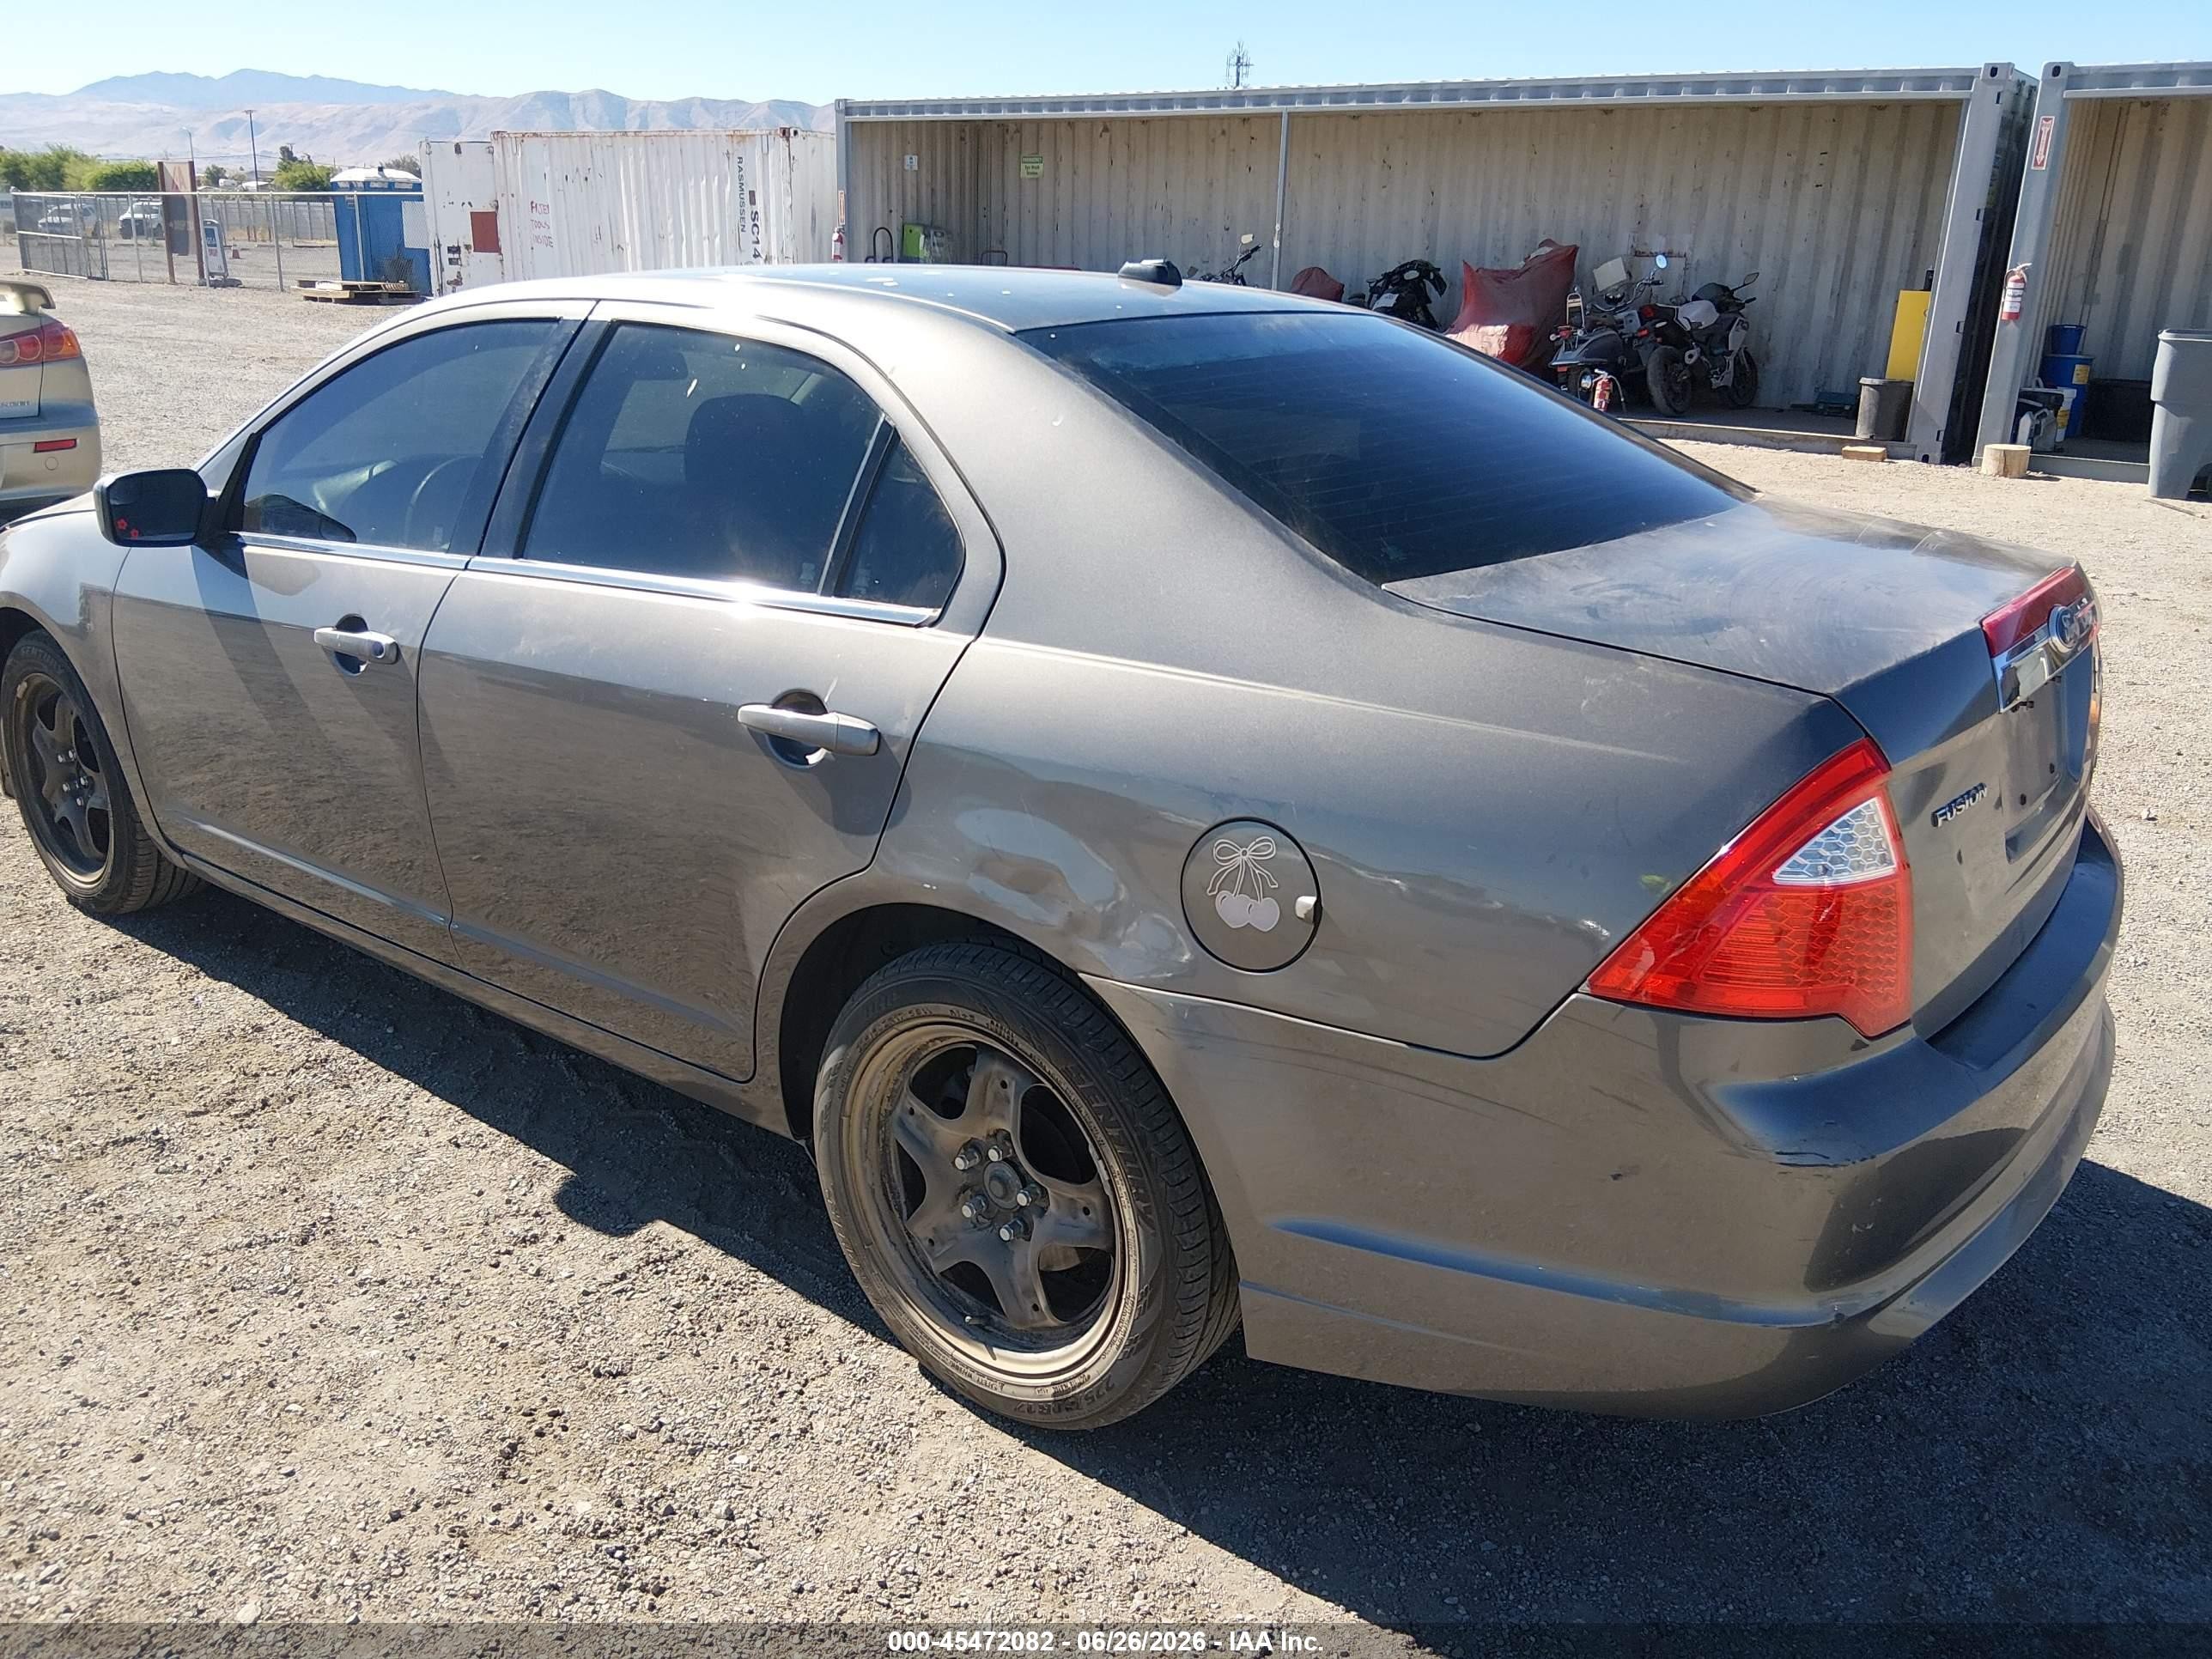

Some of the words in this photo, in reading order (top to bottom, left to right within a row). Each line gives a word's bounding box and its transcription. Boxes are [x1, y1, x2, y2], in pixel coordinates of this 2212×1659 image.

[737, 156, 746, 233] RASMUSSEN
[750, 210, 763, 259] SC14
[1931, 782, 1987, 828] FUSION
